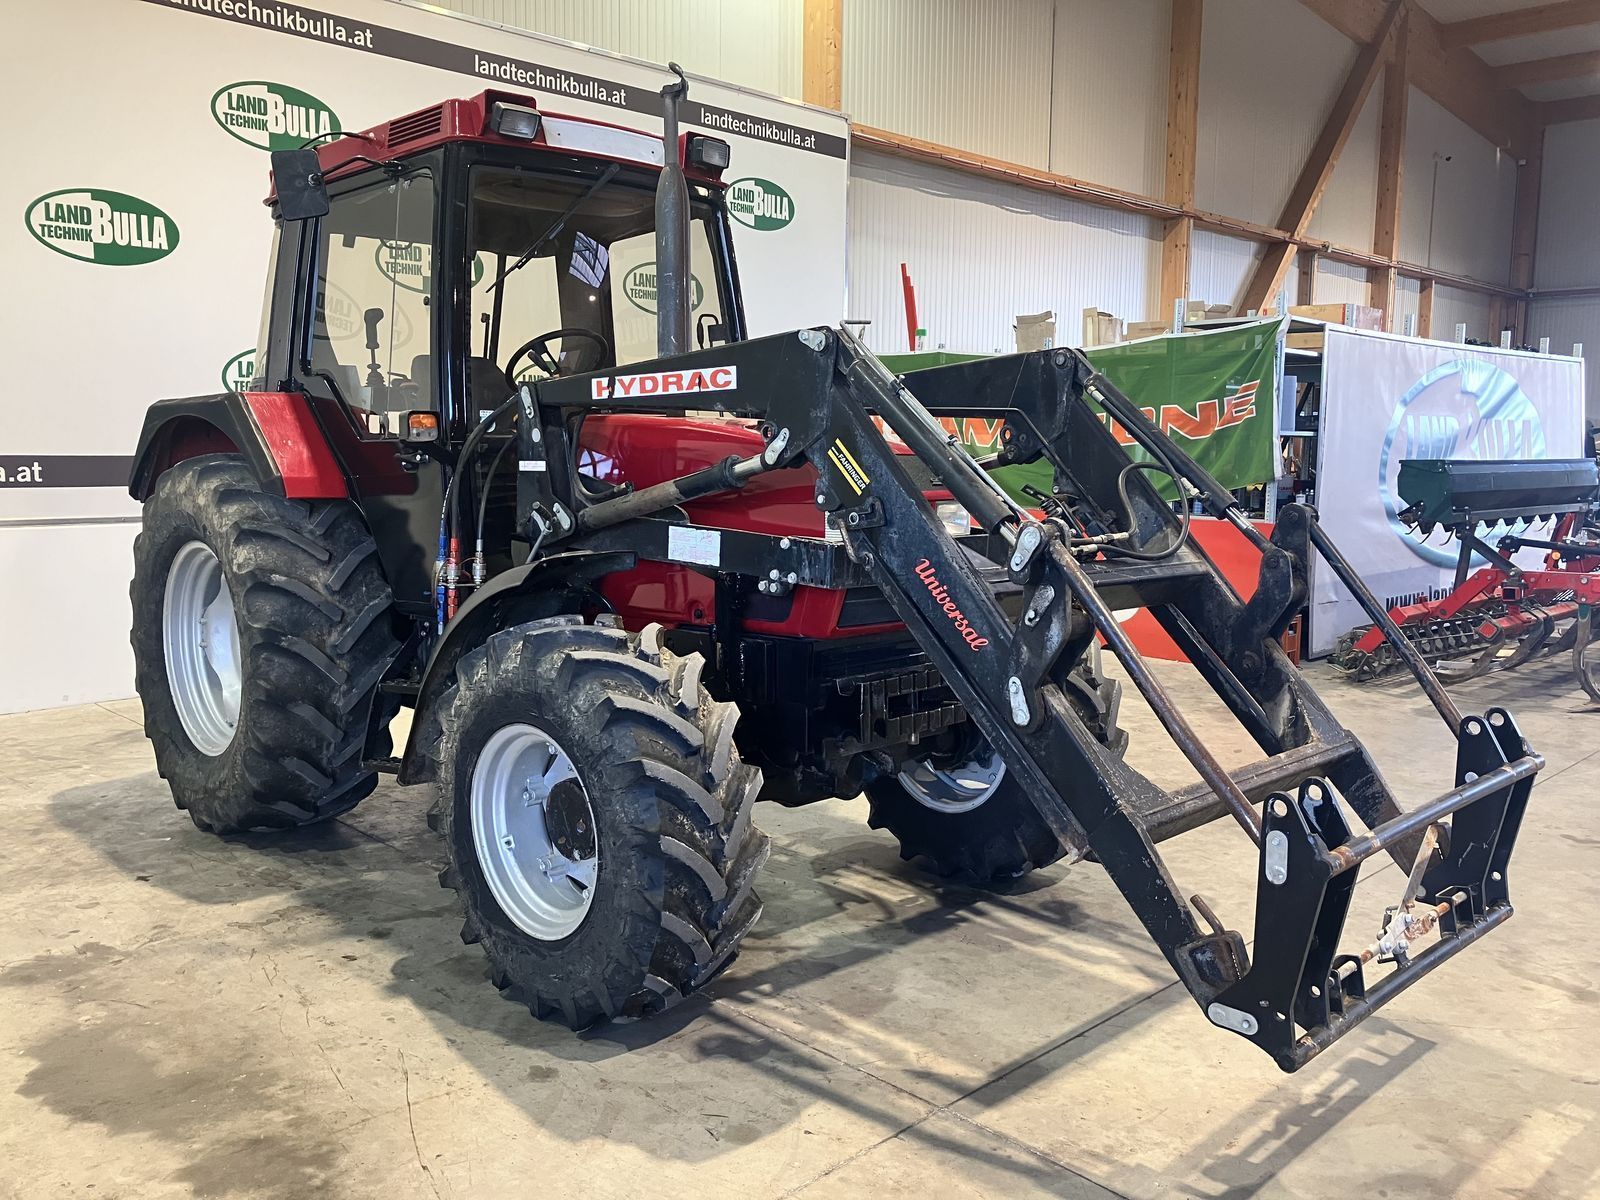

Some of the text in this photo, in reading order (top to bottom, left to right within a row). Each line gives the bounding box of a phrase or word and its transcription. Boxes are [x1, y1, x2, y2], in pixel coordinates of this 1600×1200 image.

[474, 54, 627, 106] landtechnikbulla.at
[227, 92, 268, 116] LAND
[267, 92, 333, 143] BULLA
[222, 111, 269, 132] TECHNIK
[701, 107, 816, 149] landtechnikbulla.at
[729, 201, 755, 215] TECHNIK
[732, 186, 754, 203] LAND
[754, 185, 790, 221] BULLA
[44, 201, 92, 225] LAND
[91, 200, 169, 250] BULLA
[38, 223, 94, 242] TECHNIK
[596, 368, 733, 398] HYDRAC
[838, 453, 866, 490] FAHRINGER
[914, 558, 989, 652] Universal
